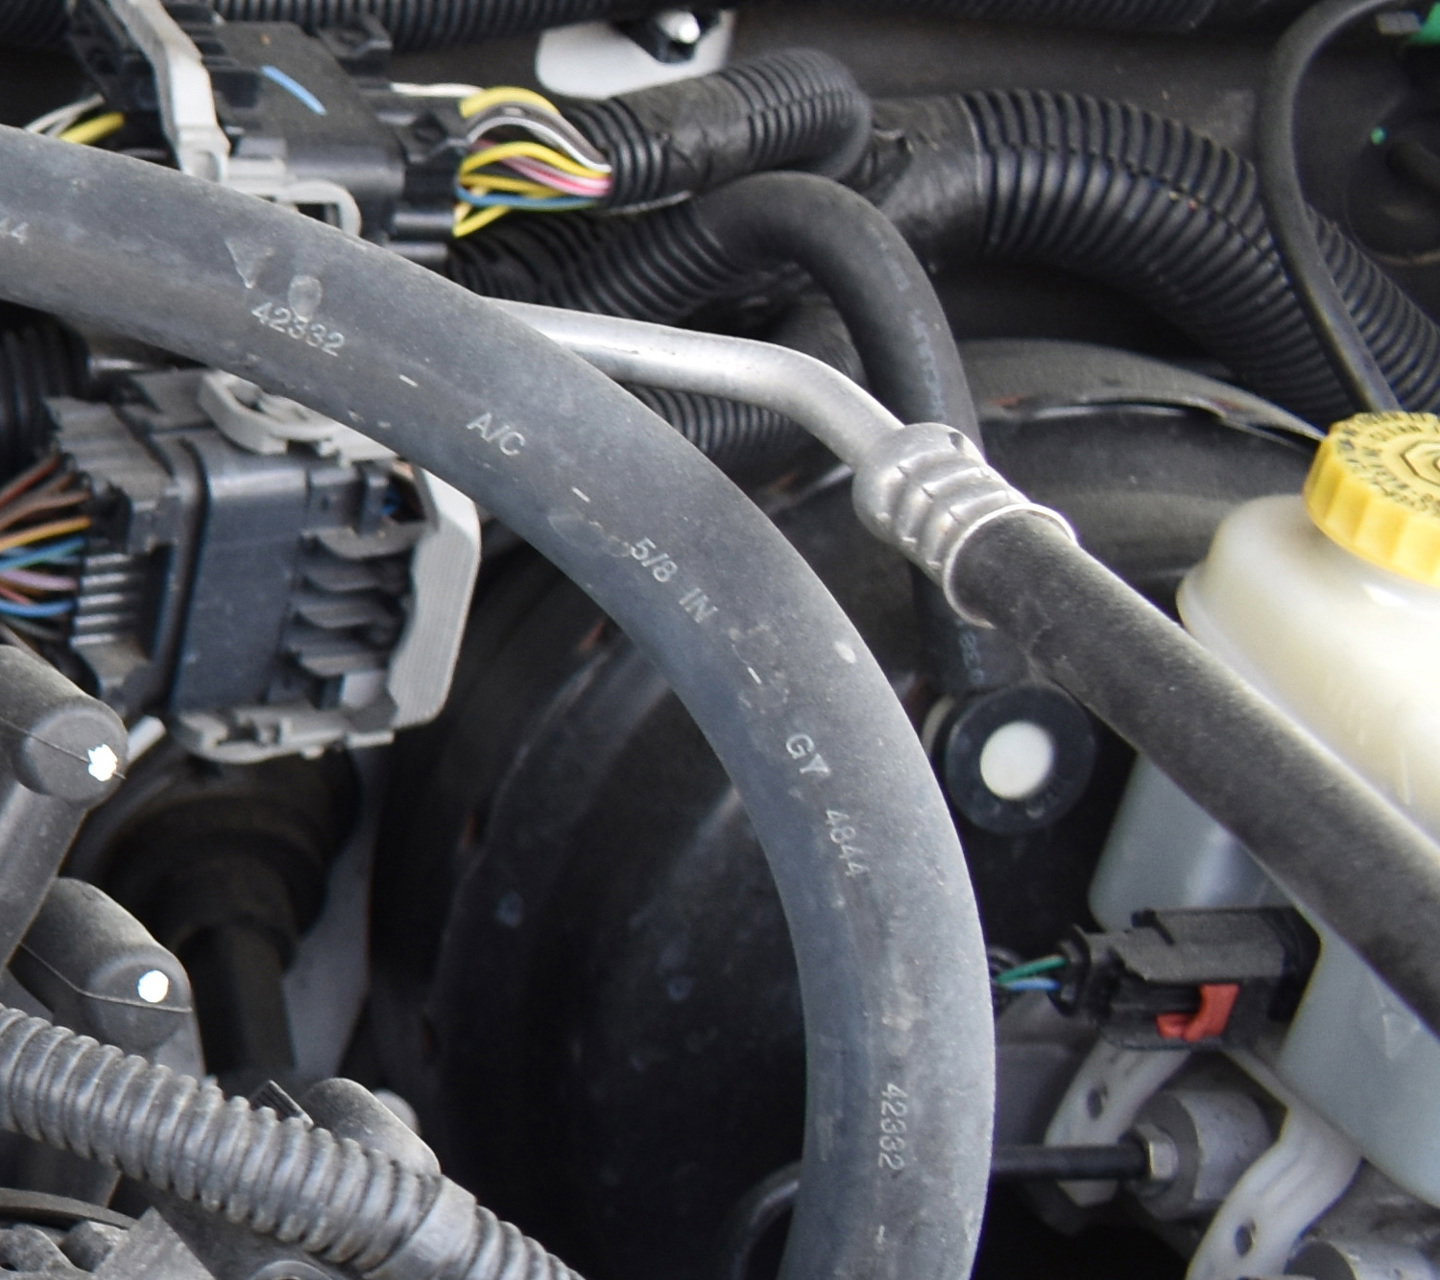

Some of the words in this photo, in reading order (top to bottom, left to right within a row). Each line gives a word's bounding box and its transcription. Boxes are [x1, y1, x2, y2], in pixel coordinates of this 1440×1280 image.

[250, 301, 346, 358] 42332
[466, 411, 527, 458] A/C
[628, 538, 679, 584] 5/8
[679, 587, 720, 625] IN
[785, 733, 830, 775] GY
[825, 808, 871, 878] 4844
[878, 1082, 909, 1173] 42332
